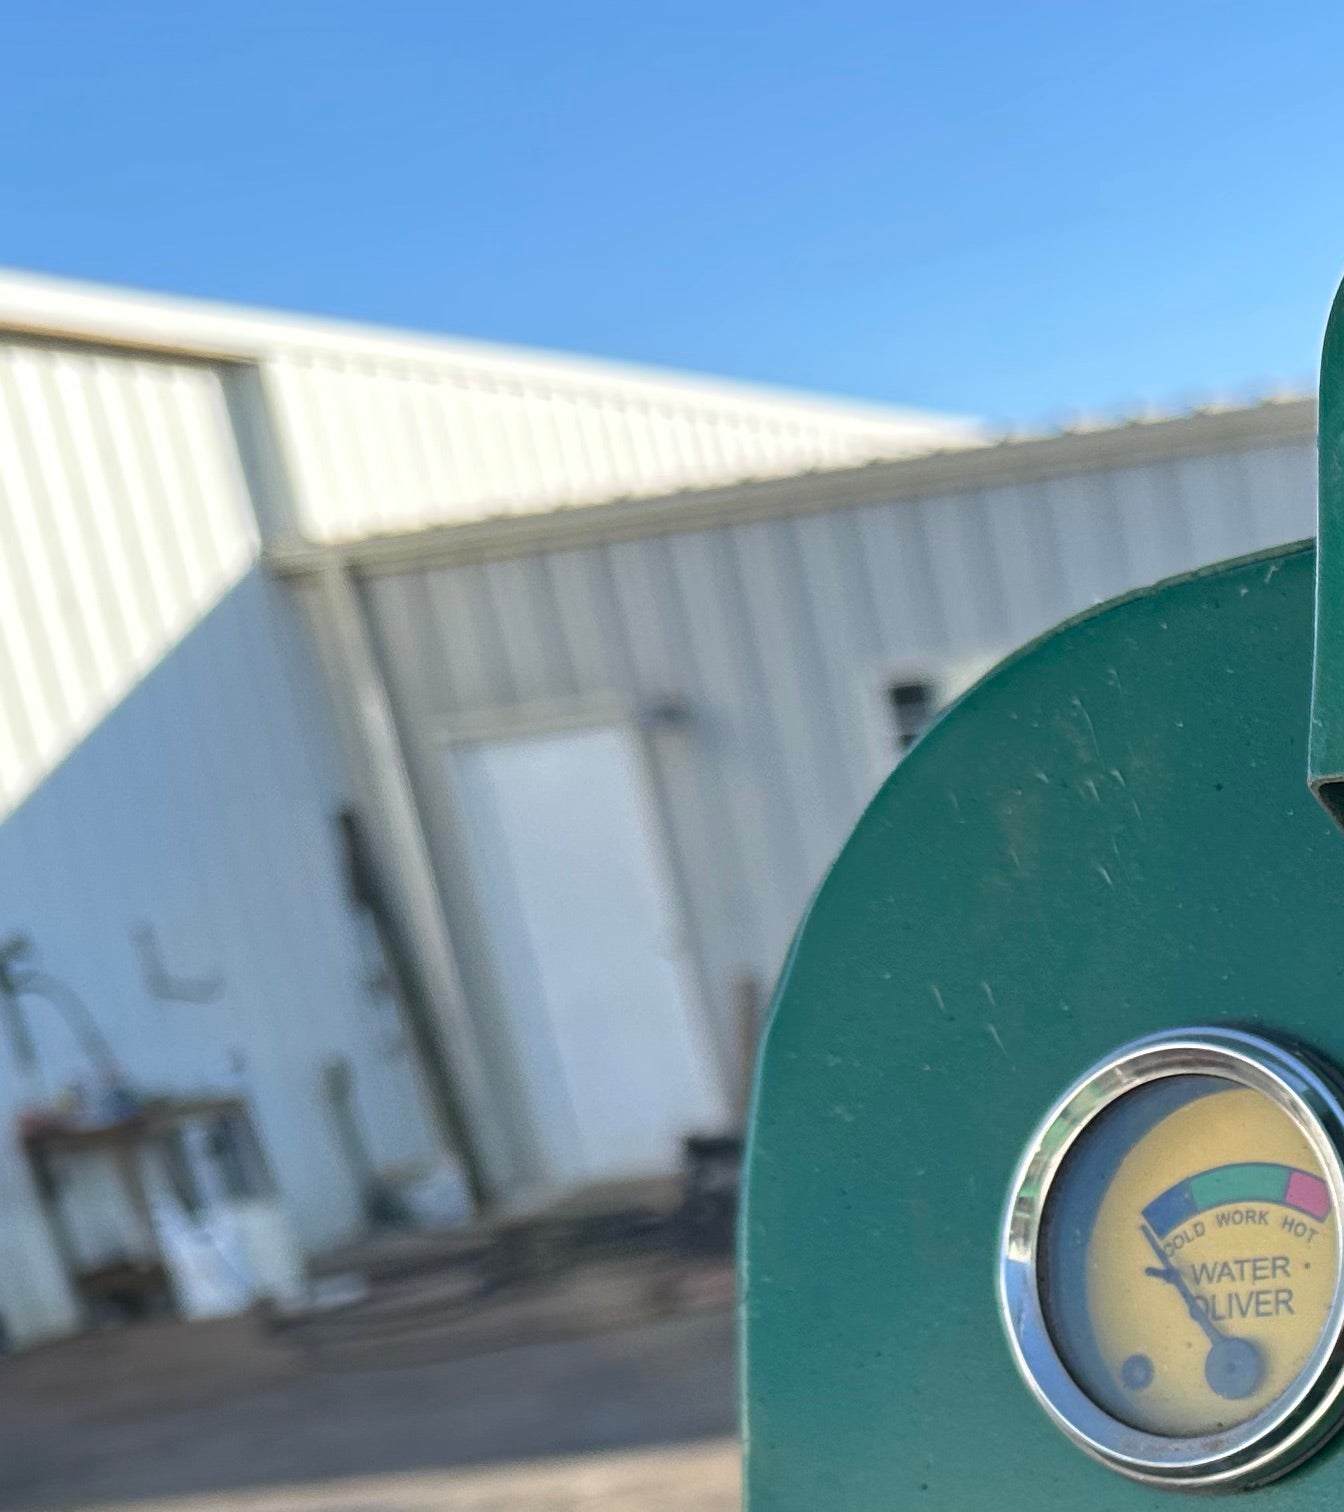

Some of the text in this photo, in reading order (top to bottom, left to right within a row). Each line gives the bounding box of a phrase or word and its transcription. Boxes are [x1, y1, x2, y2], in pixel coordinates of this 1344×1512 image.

[1162, 1210, 1319, 1257] COLD WORK HOT
[1191, 1256, 1291, 1284] WATER
